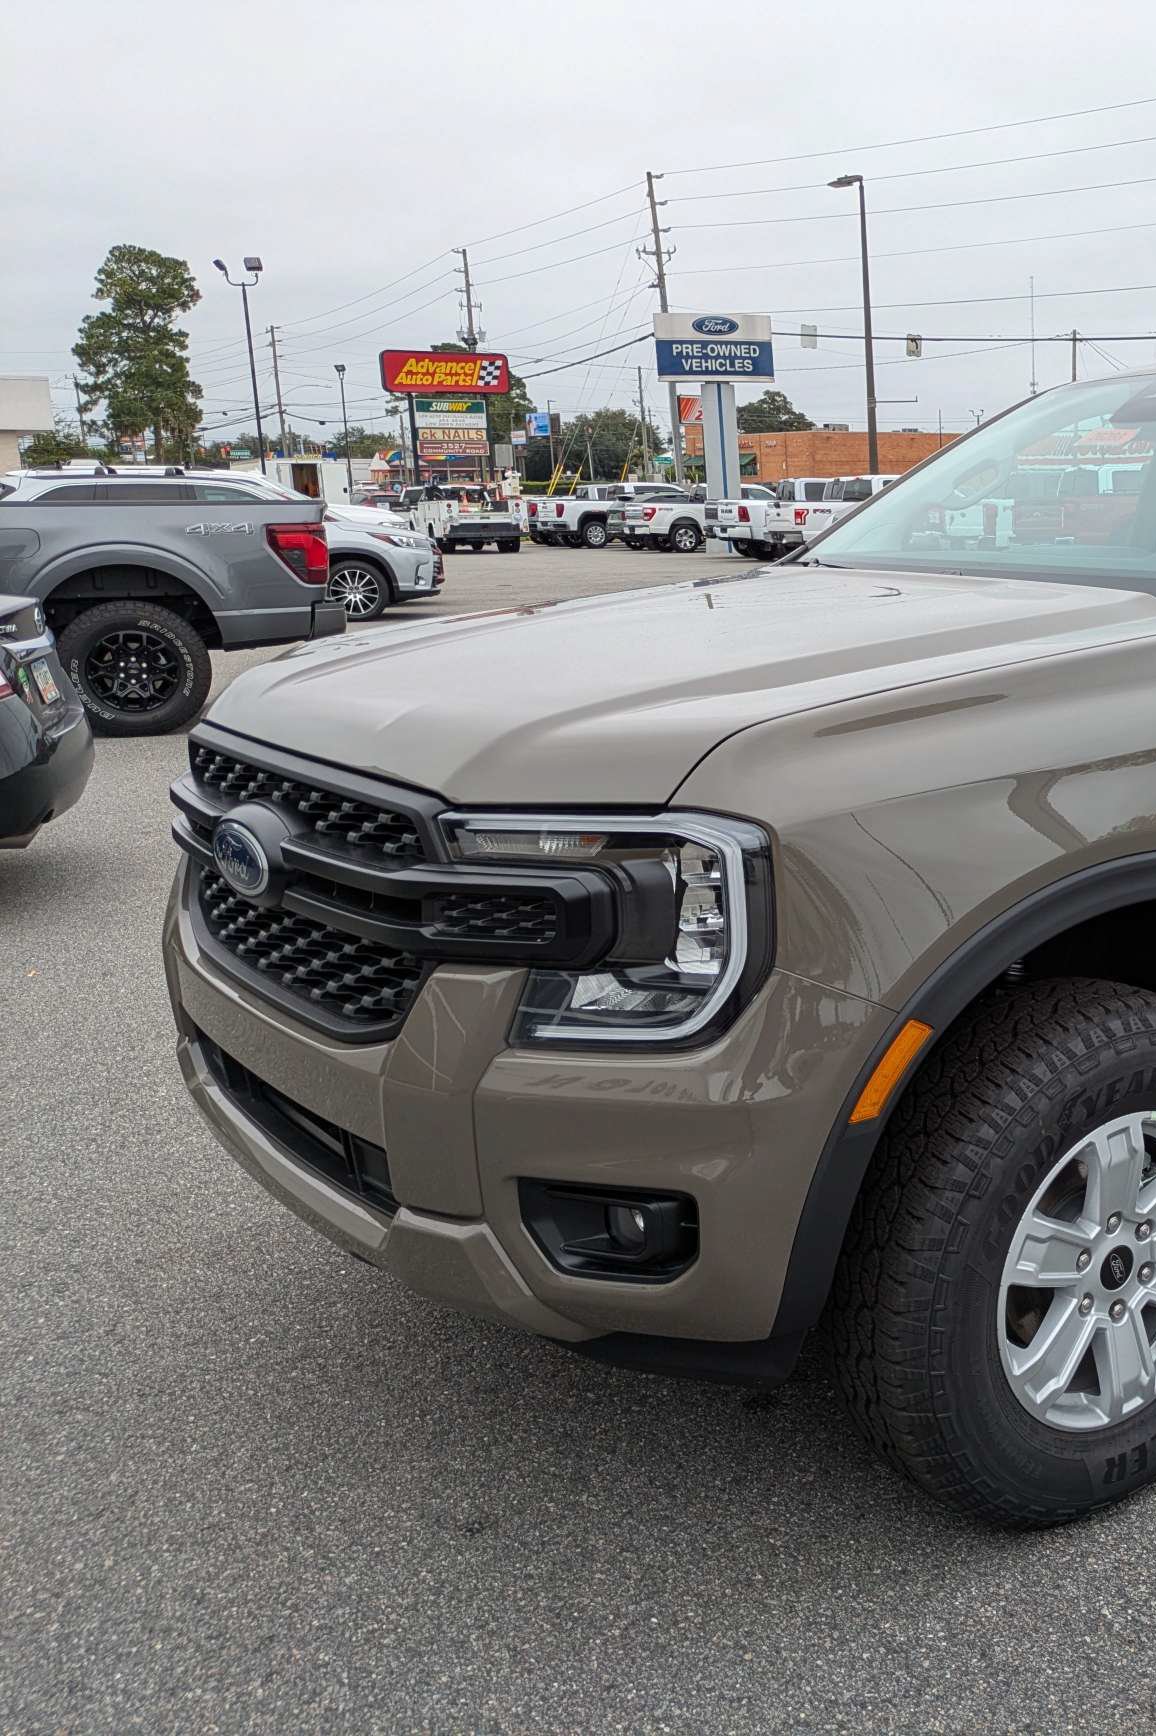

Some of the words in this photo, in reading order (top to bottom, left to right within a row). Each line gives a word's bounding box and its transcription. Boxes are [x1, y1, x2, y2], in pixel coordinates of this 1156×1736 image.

[702, 319, 730, 332] Ford
[672, 344, 760, 357] PRE-OWNED
[402, 358, 475, 374] Advance
[682, 359, 754, 371] VEHICLES
[394, 373, 432, 385] Auto
[433, 374, 473, 386] Parts
[429, 402, 472, 411] SUBWAY
[442, 430, 484, 440] NAILS
